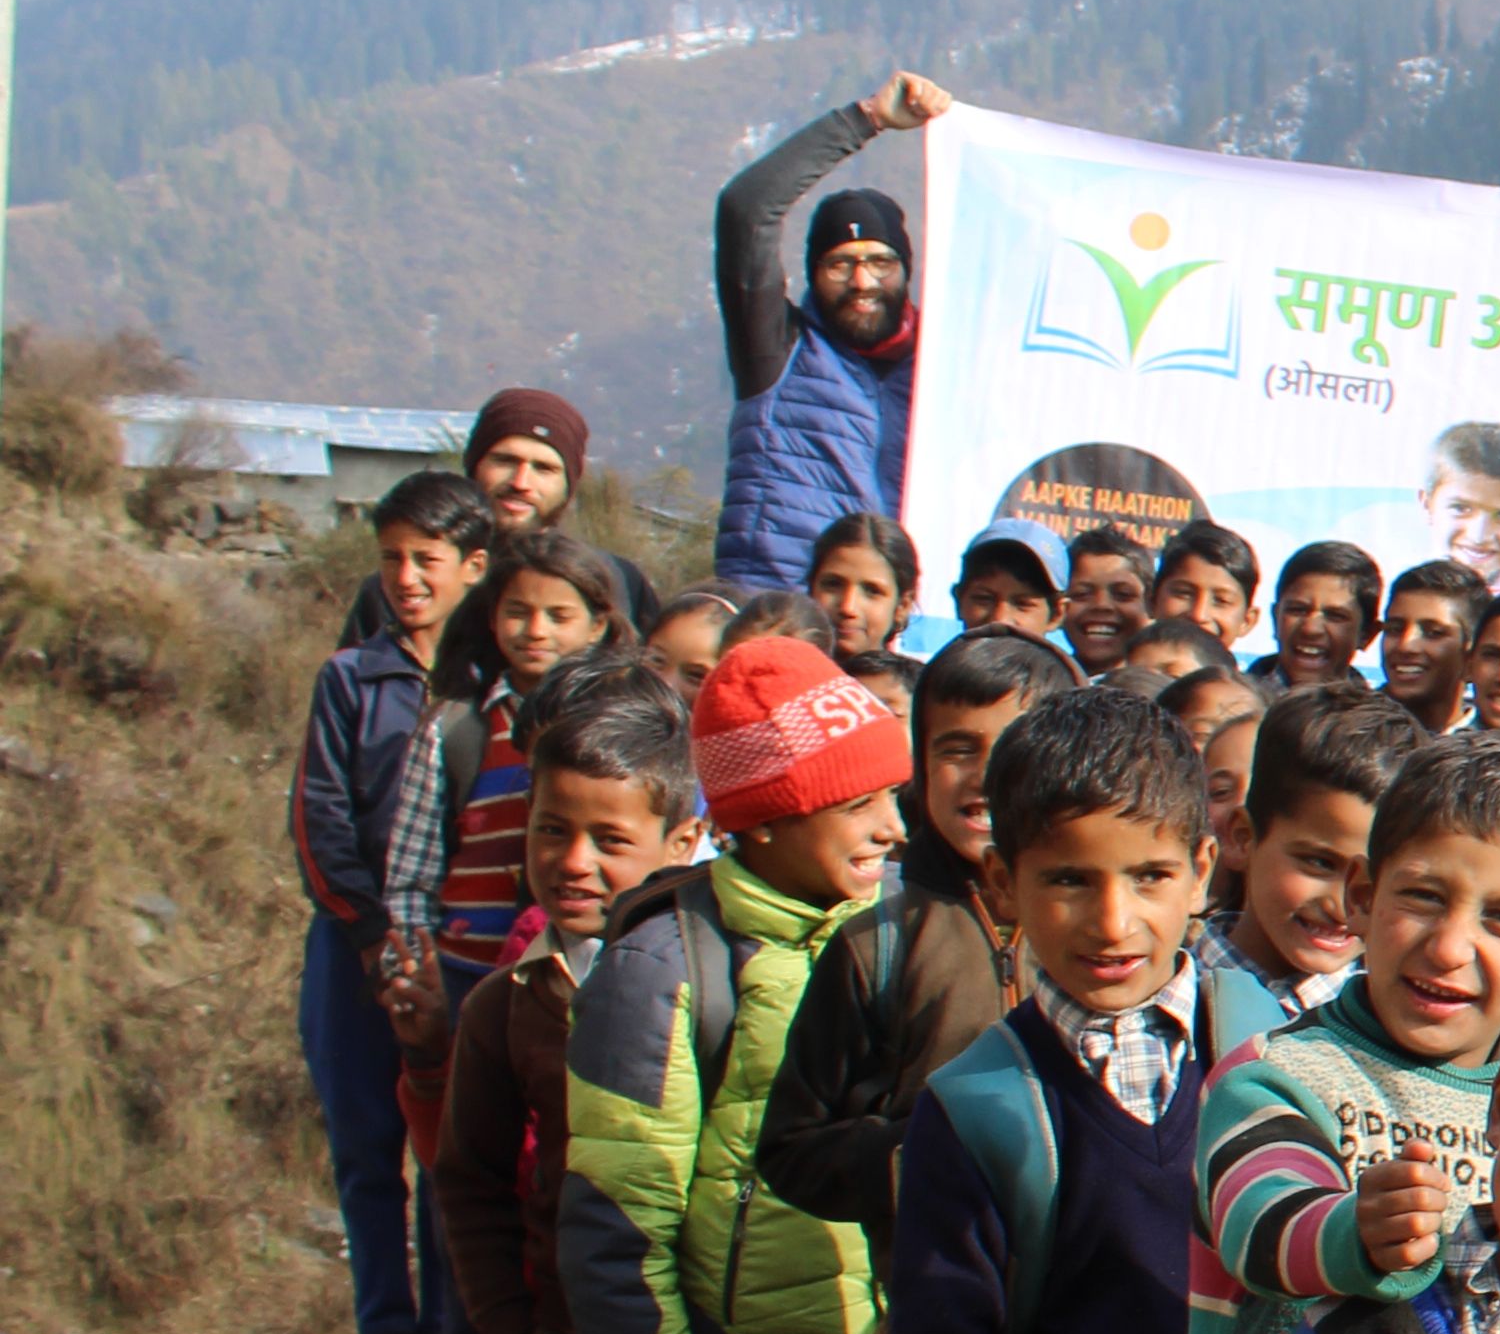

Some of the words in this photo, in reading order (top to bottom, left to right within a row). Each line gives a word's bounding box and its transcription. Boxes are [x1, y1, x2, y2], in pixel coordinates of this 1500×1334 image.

[1274, 267, 1457, 368] समूण
[1263, 360, 1396, 414] (ओसला)
[1020, 479, 1093, 511] AAPKE
[1094, 487, 1193, 521] HAATHON
